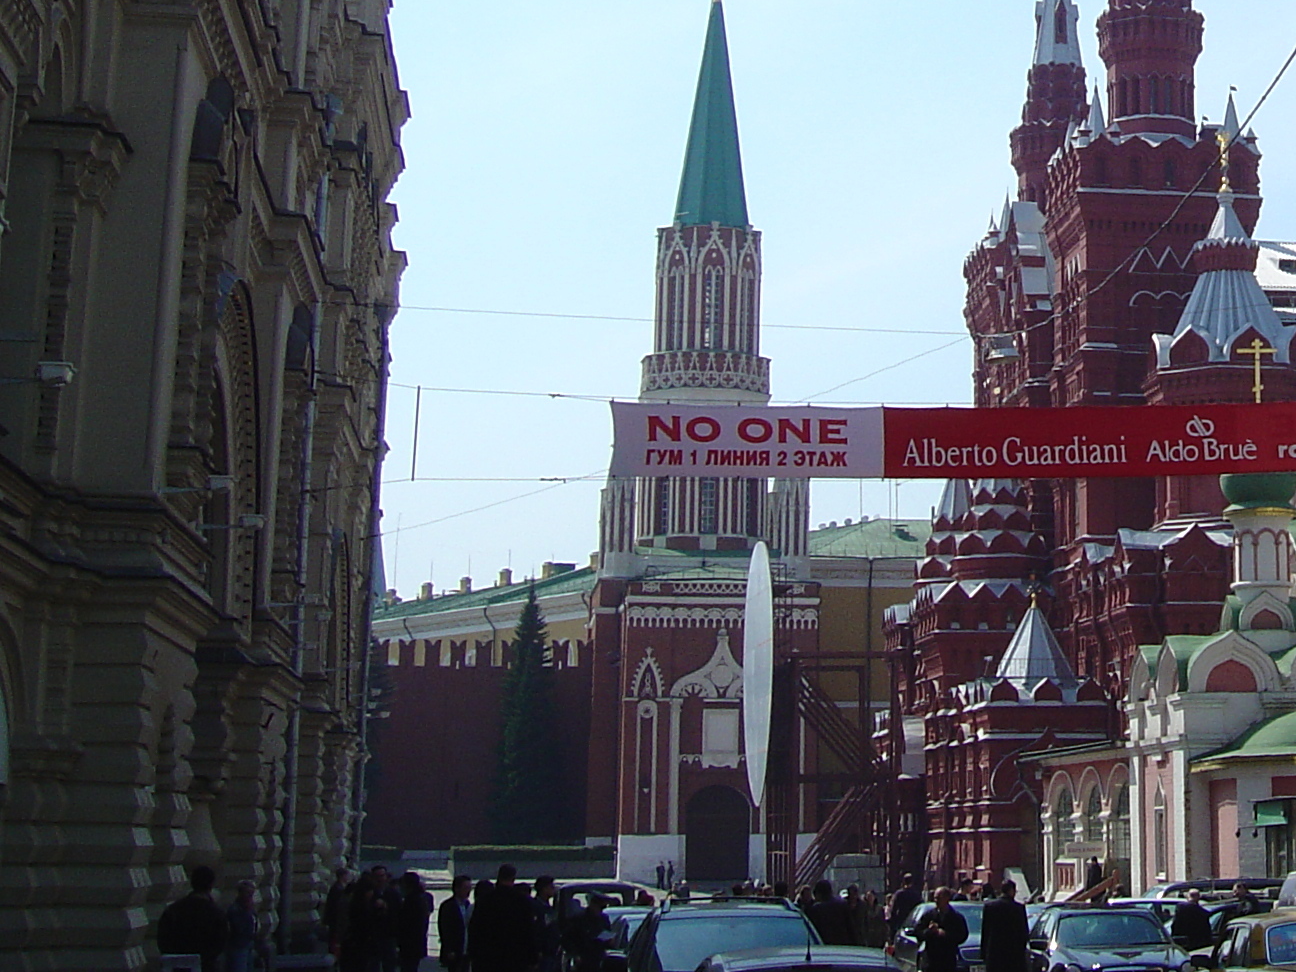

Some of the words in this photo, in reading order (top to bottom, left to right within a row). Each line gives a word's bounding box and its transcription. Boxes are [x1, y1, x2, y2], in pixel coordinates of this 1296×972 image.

[647, 415, 721, 444] NO
[737, 417, 849, 446] ONE
[645, 448, 683, 466] ГУМ
[689, 449, 698, 466] 1
[704, 449, 771, 467] ЛИНИЯ
[777, 450, 788, 467] 2
[793, 451, 849, 468] ЭТАЖ
[902, 437, 998, 467] Alberto
[1001, 436, 1127, 466] Guardiani
[1146, 438, 1199, 463] Aldo
[1203, 437, 1258, 461] Bruè
